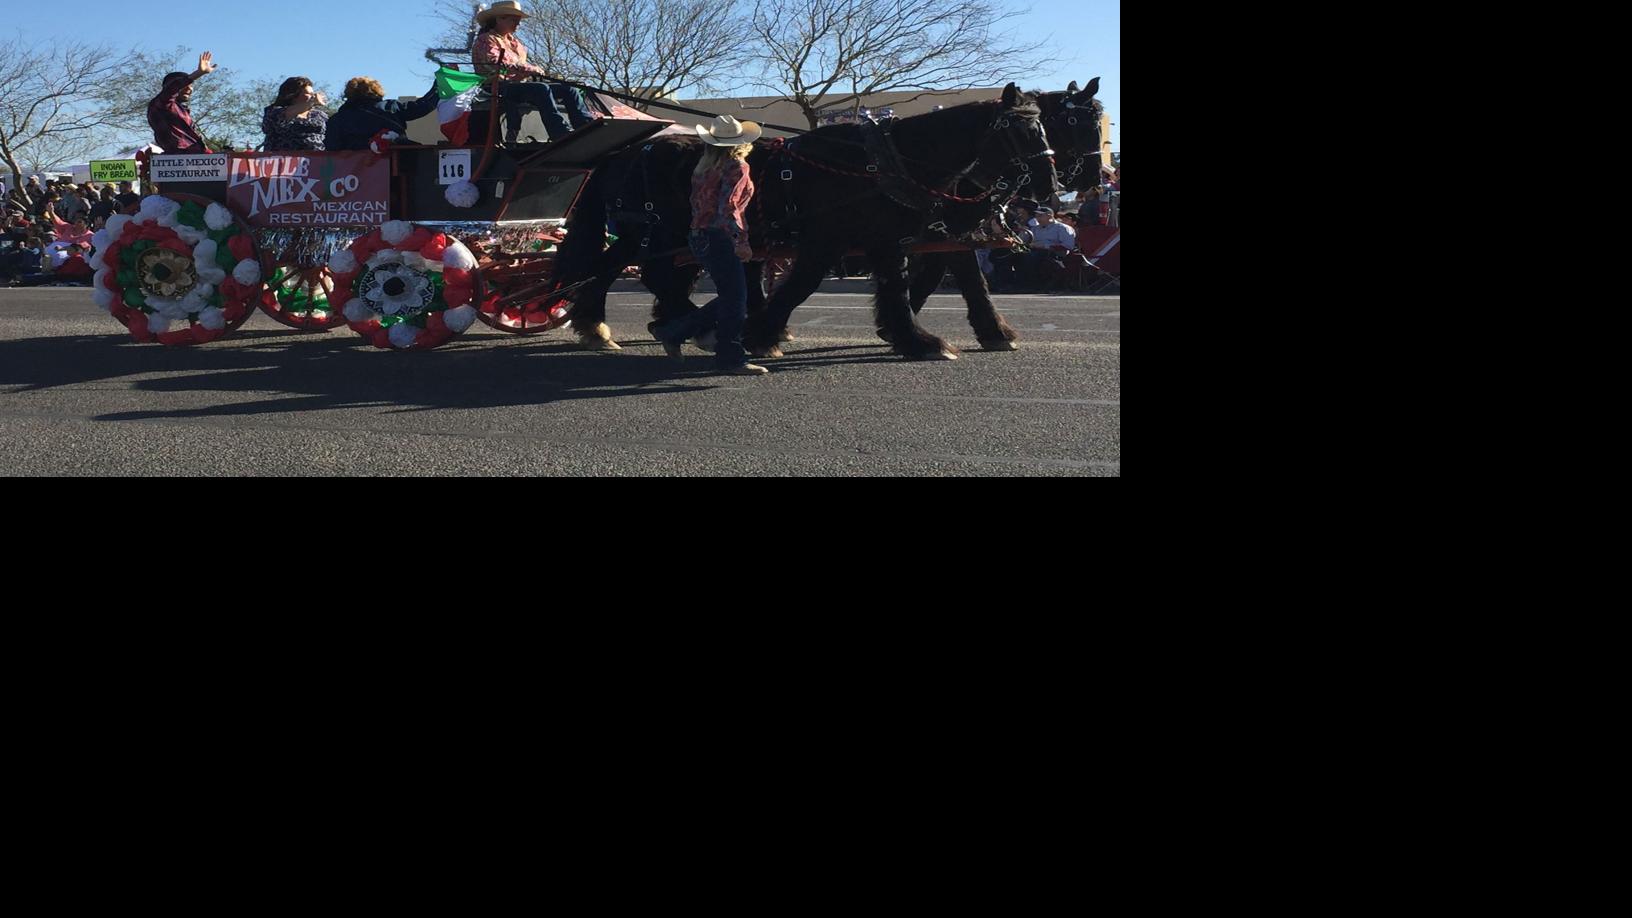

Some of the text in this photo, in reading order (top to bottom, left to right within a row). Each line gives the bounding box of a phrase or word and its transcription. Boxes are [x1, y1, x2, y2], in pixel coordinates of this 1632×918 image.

[152, 158, 226, 167] LITTLE MEXICO
[158, 169, 220, 178] RESTAURANT
[228, 155, 311, 188] LITTLE
[442, 164, 464, 178] 116
[313, 200, 387, 212] MEXICAN
[269, 212, 387, 224] RESTAURANT
